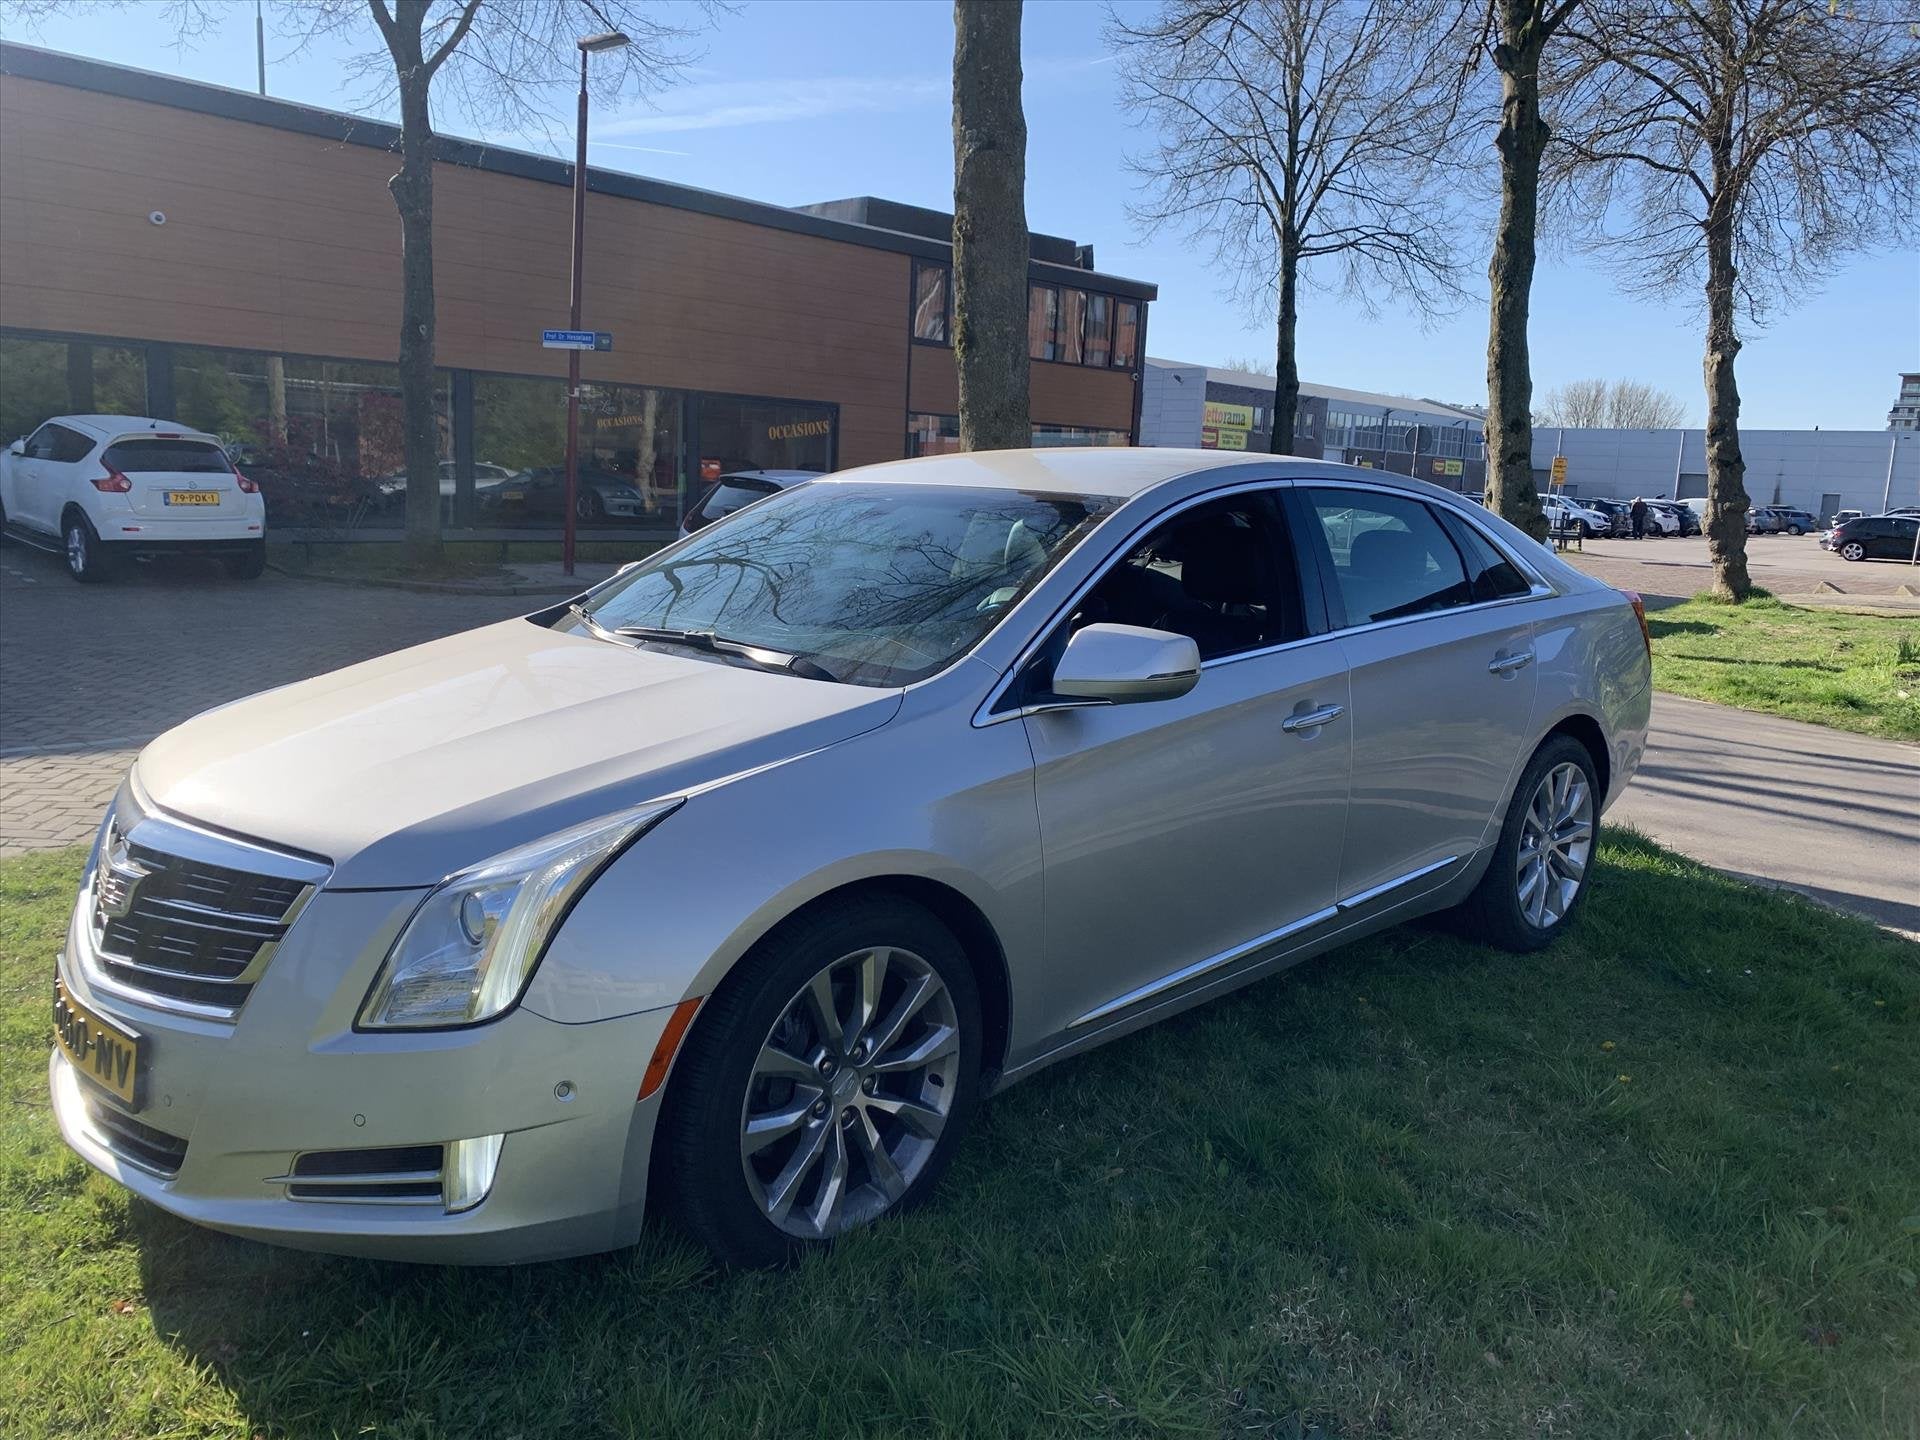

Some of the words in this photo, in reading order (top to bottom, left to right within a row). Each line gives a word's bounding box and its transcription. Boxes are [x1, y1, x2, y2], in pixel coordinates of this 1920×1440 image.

[596, 415, 643, 428] OCCASIONS
[768, 420, 829, 440] OCCASIONS
[173, 494, 215, 502] 79-PDK-1
